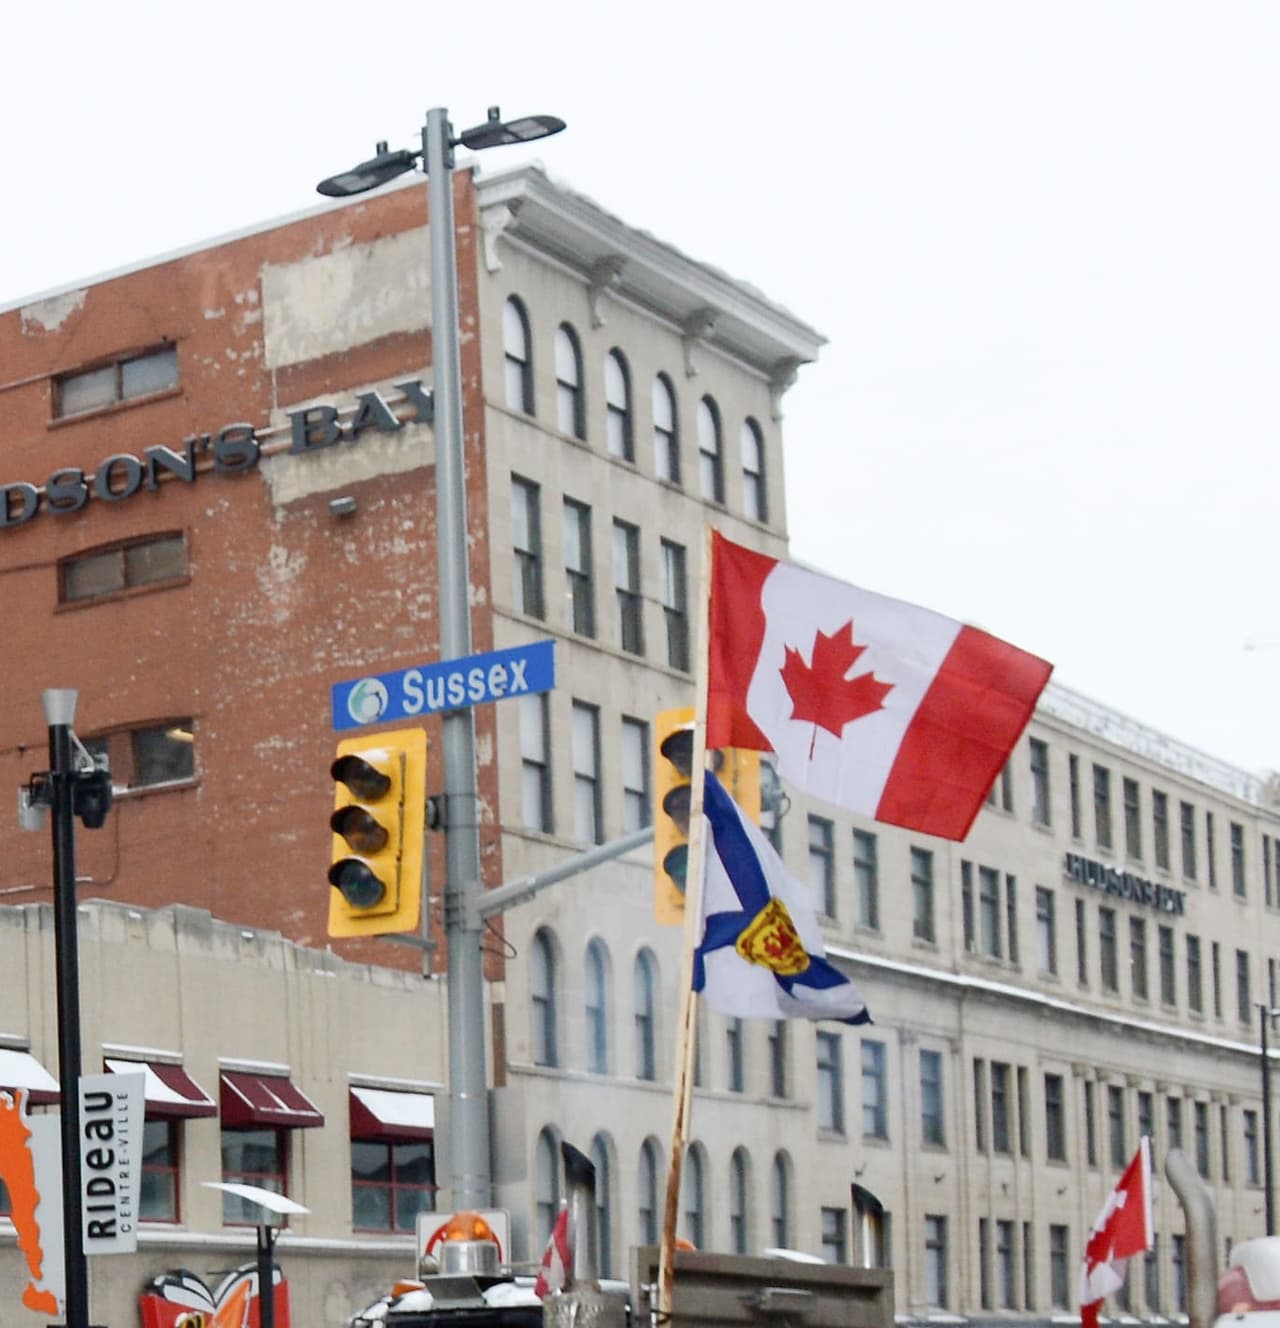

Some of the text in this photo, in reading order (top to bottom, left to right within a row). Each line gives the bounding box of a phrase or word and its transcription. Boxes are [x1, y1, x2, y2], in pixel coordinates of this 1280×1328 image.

[287, 378, 435, 455] BAY
[402, 659, 529, 714] Sussex
[117, 1093, 132, 1233] CENTRE-VILLE
